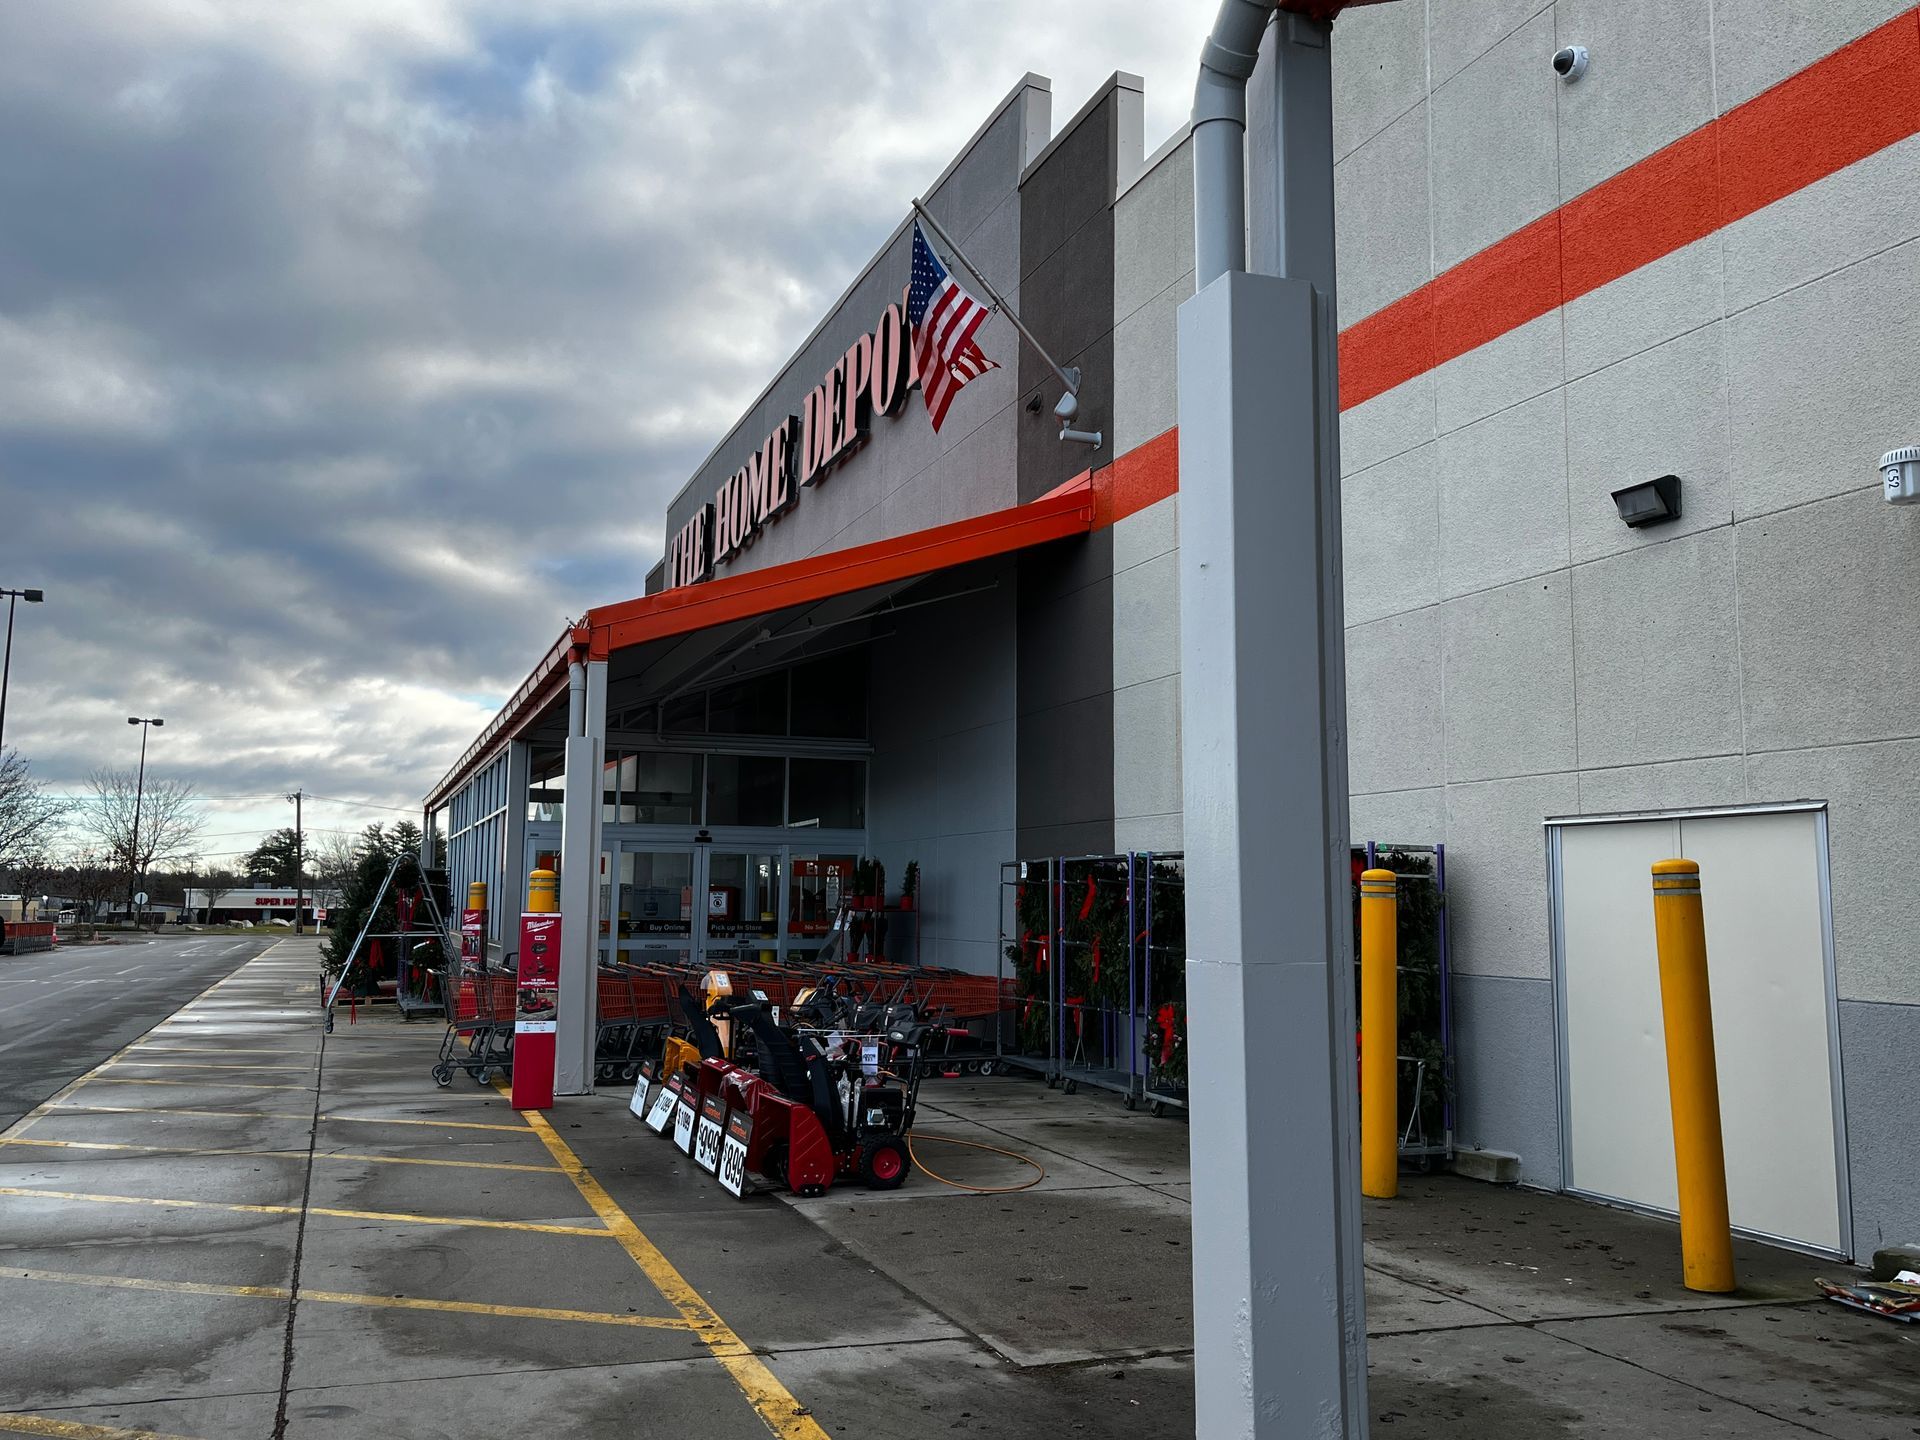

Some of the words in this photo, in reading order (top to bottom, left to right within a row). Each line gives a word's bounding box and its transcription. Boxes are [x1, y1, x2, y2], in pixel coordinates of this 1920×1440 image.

[1888, 468, 1900, 489] C52
[670, 503, 709, 587] THE
[714, 416, 794, 563] HOME
[806, 861, 841, 876] Ener
[255, 897, 281, 906] SUPER
[283, 897, 312, 906] BUFET
[723, 1141, 745, 1189] $899
